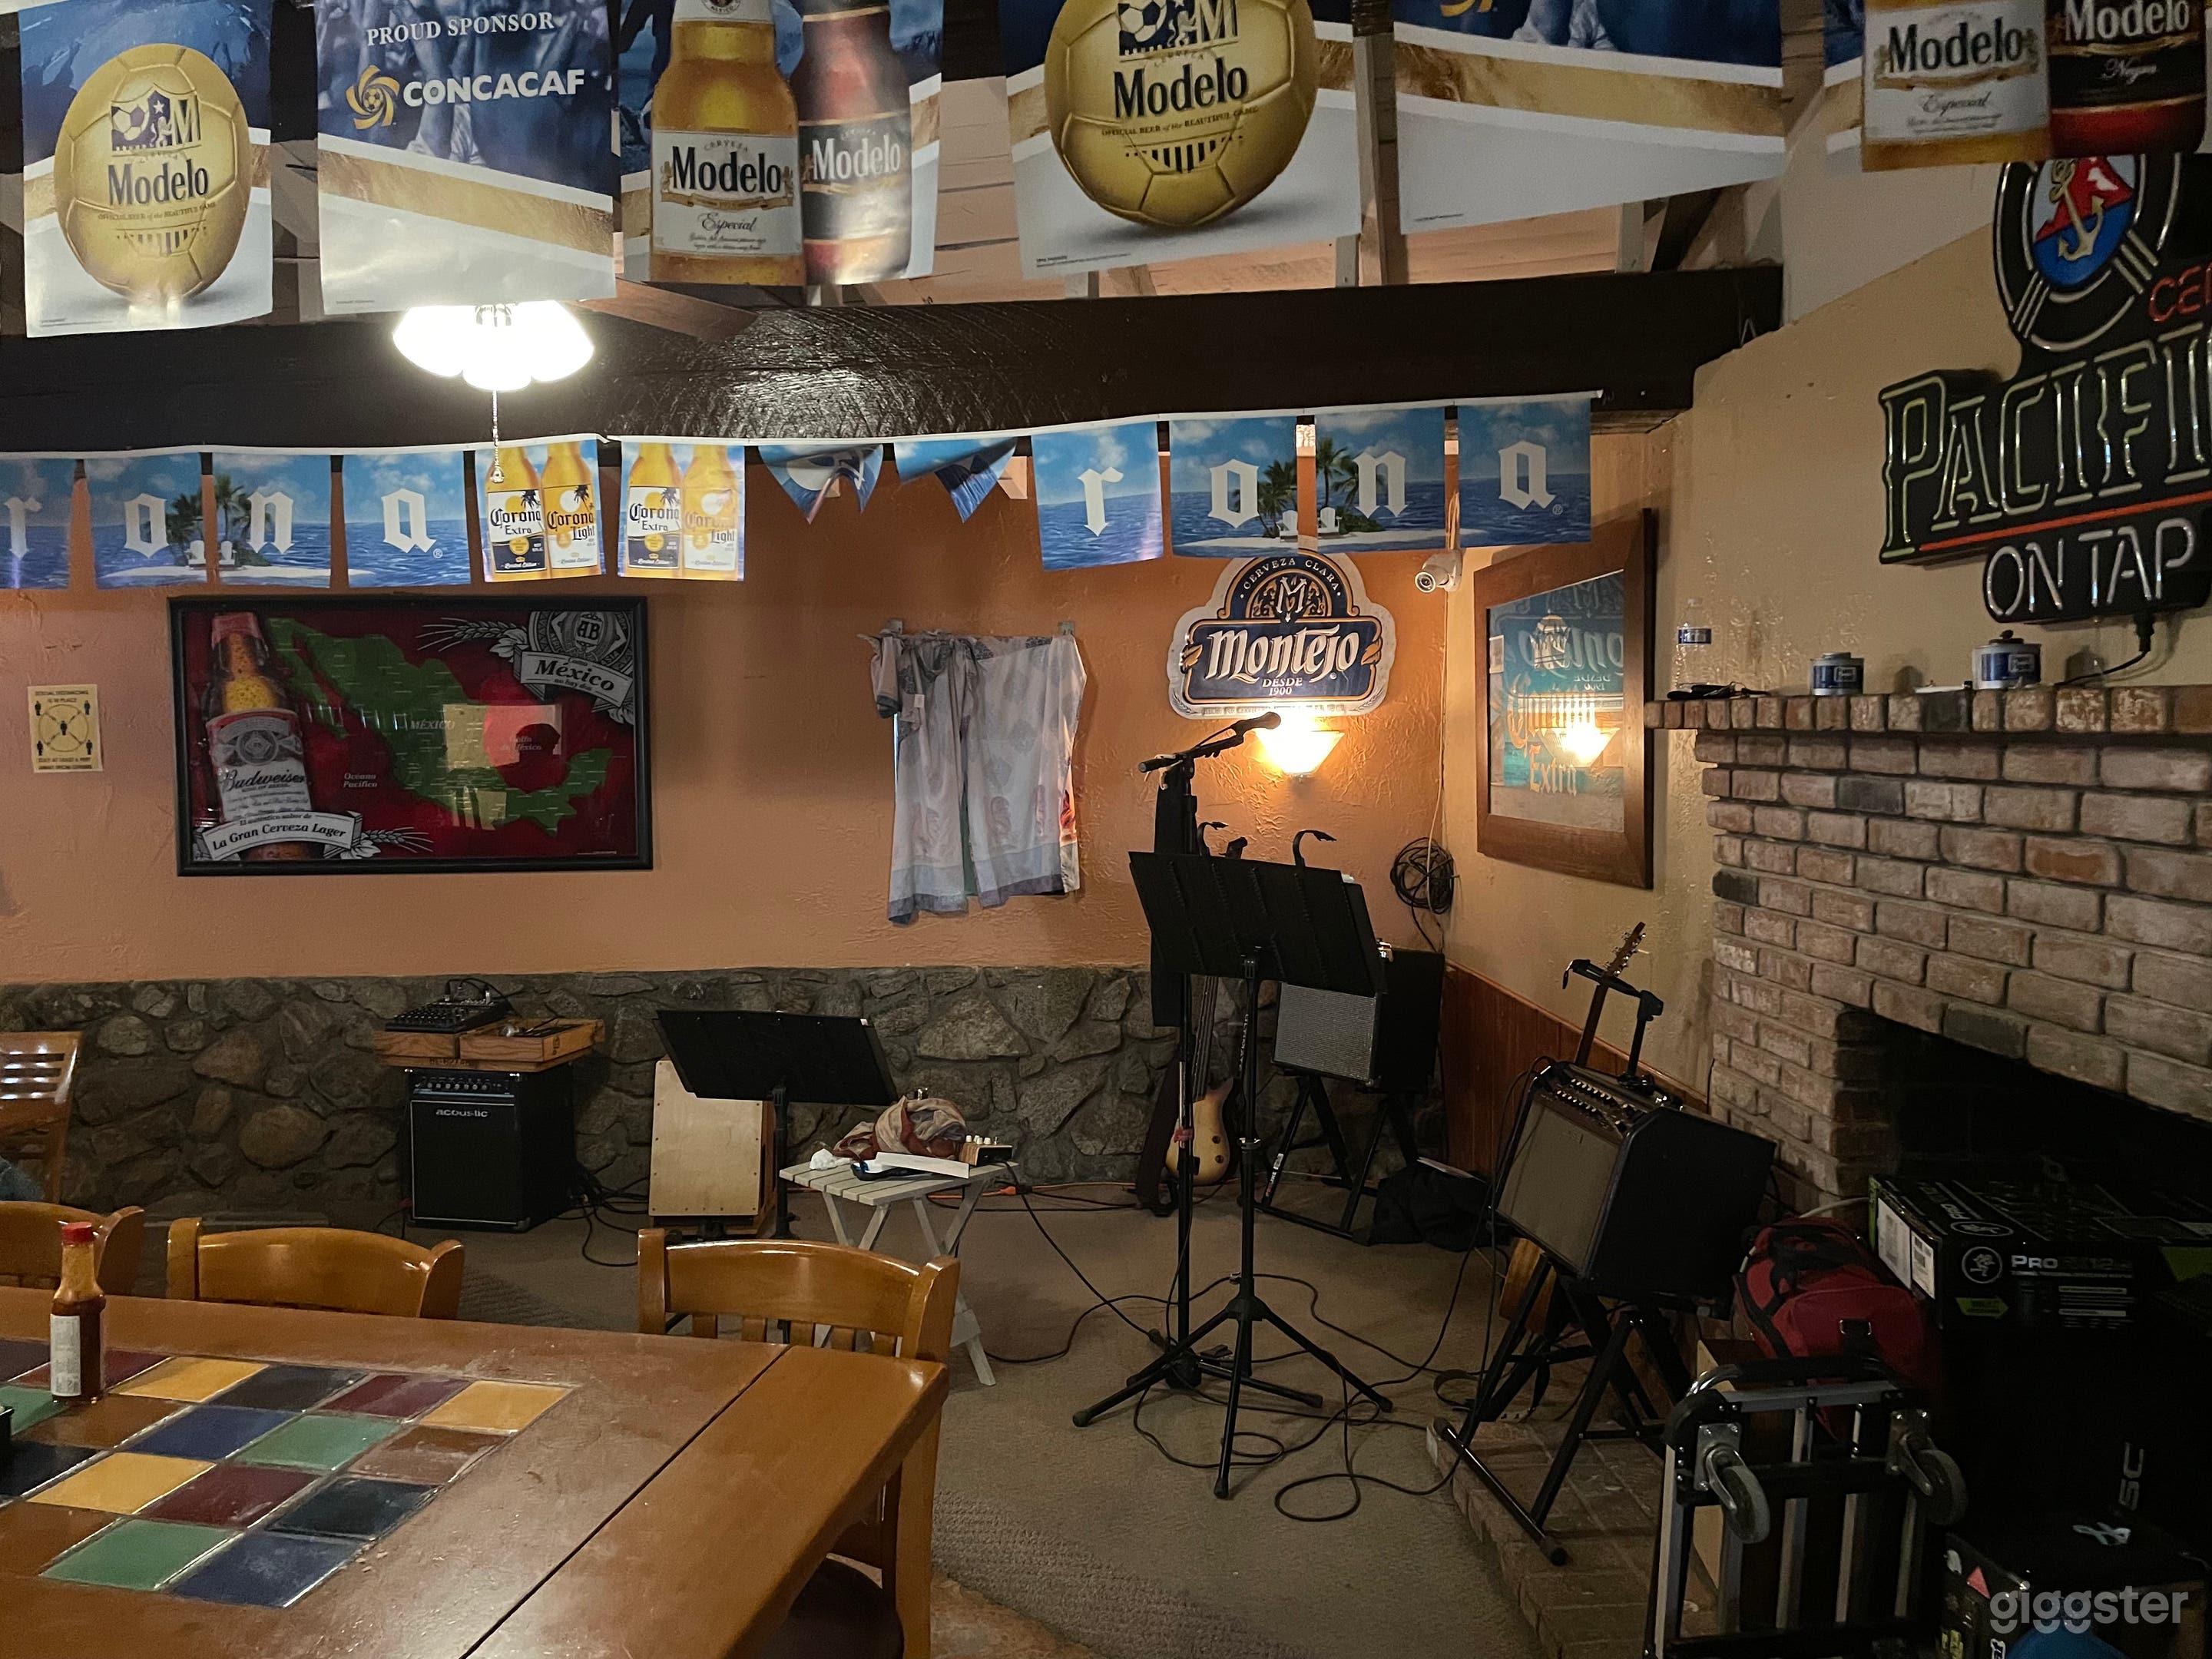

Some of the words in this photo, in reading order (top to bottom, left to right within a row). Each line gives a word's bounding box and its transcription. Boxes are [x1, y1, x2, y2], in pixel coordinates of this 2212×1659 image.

[366, 20, 442, 46] PROUD
[448, 12, 555, 38] SPONSOR
[2065, 0, 2190, 41] Modelo
[1889, 17, 2023, 73] Modelo
[402, 68, 585, 108] CONCACAF
[1113, 56, 1248, 119] Modelo
[1140, 125, 1162, 134] BEER
[1184, 113, 1231, 128] BEAUTIFUL
[671, 146, 782, 194] Modelo
[810, 133, 901, 181] Modelo
[108, 158, 209, 206] Modelo
[697, 212, 757, 235] Especial
[2149, 264, 2212, 323] CE
[1880, 323, 2212, 559] PACIFI
[490, 508, 541, 530] Corona
[546, 509, 594, 533] Corona
[629, 502, 680, 526] Corona
[641, 520, 669, 532] Extra
[684, 509, 736, 535] Cor
[505, 524, 532, 536] Extra
[571, 525, 595, 541] Light
[709, 529, 735, 544] Light
[1243, 557, 1296, 591] CERVEZA
[1305, 559, 1340, 591] CLARA
[1986, 538, 2063, 614] ON
[2078, 518, 2194, 608] TAP
[1204, 624, 1360, 684] Montejo
[534, 659, 614, 691] México
[1261, 677, 1303, 687] DESDE
[1268, 687, 1293, 696] 1900
[410, 718, 455, 730] MÉXICO
[222, 769, 305, 793] Budweiser
[212, 839, 227, 851] La
[229, 829, 259, 843] Gran
[261, 823, 309, 836] Cerveza
[311, 822, 347, 838] Lager
[435, 1108, 488, 1118] acoustic
